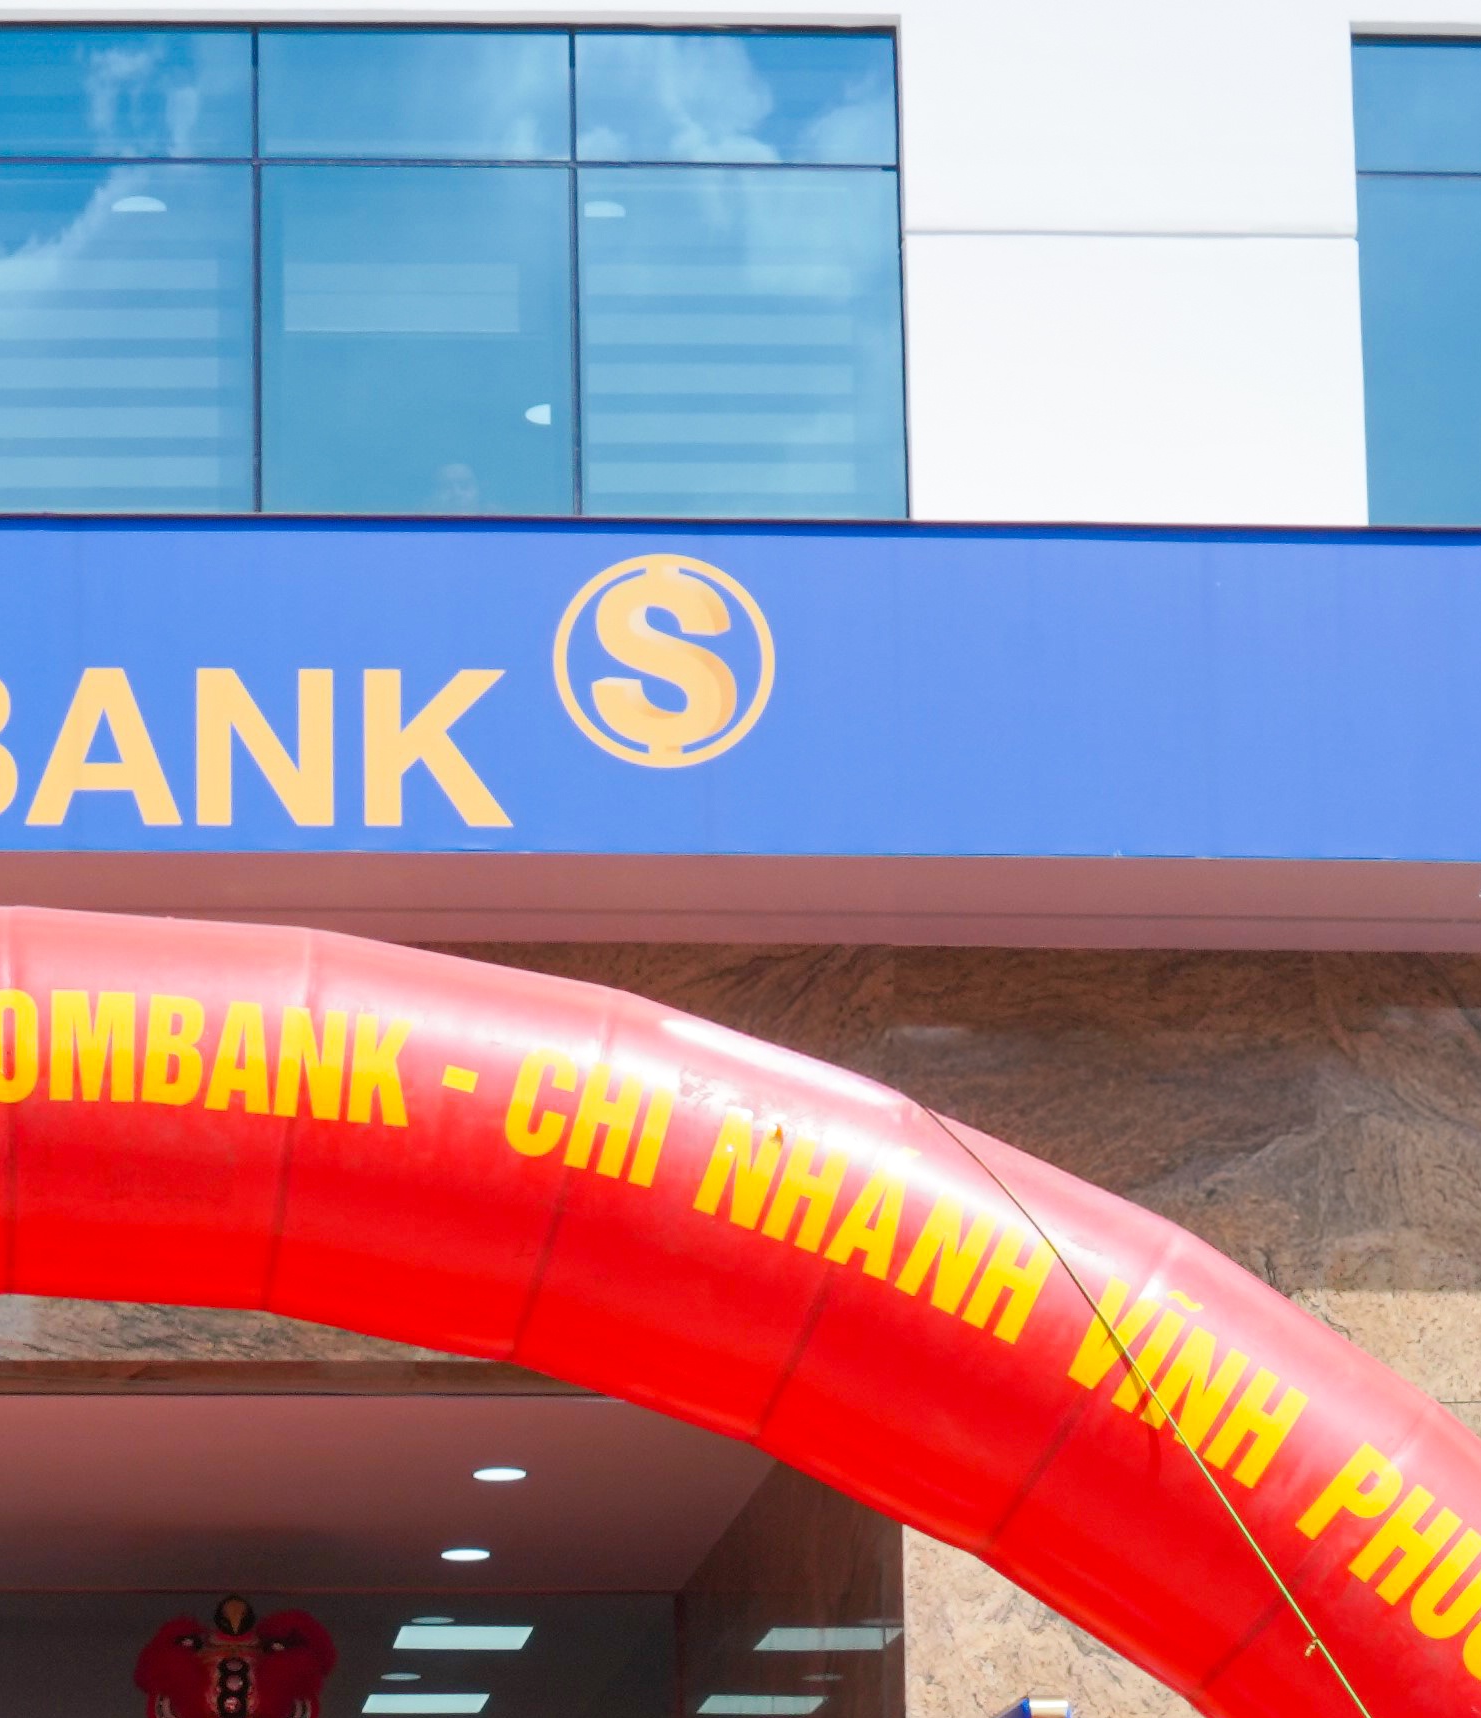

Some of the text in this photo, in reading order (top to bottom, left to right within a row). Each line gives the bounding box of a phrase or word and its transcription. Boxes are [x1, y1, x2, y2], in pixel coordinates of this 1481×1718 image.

[503, 1049, 674, 1188] CHI
[692, 1105, 1053, 1345] NHÁNH
[1067, 1276, 1309, 1488] VĨNH
